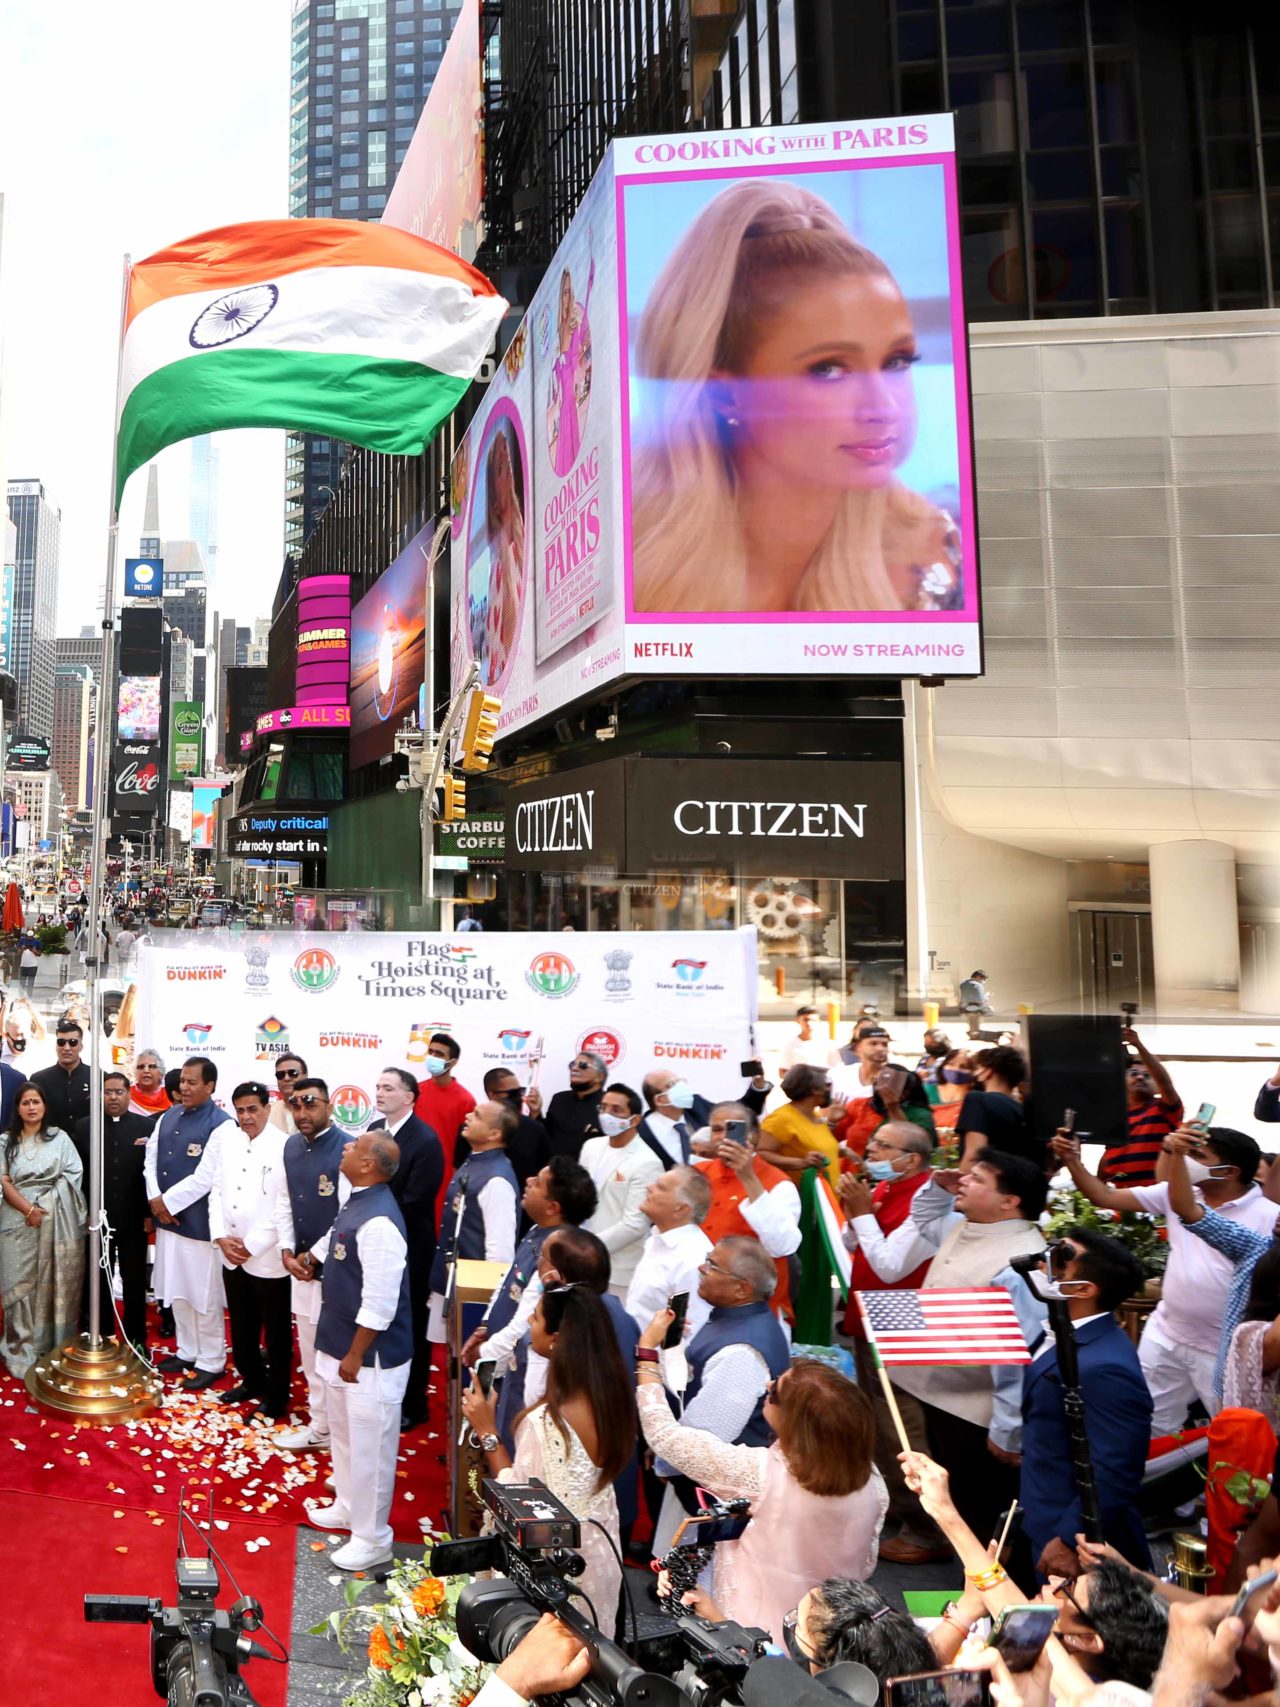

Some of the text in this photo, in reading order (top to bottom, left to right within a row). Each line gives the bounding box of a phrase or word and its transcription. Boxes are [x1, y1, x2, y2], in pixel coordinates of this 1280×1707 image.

[634, 124, 929, 165] COOKING WITH PARIS
[544, 447, 599, 534] COOKING
[560, 502, 578, 532] WITH
[544, 498, 600, 595] PARIS
[299, 629, 346, 644] SUMMER
[297, 640, 347, 653] UN&GAMES
[634, 642, 694, 659] NETFLIX
[803, 643, 965, 658] NOW STREAMING
[280, 713, 292, 722] abc
[302, 709, 330, 722] ALL
[251, 818, 277, 831] Deputy
[515, 790, 593, 853] CITIZEN
[673, 801, 868, 838] CITIZEN
[251, 840, 273, 854] rocky
[275, 840, 304, 852] start
[307, 839, 320, 852] in
[622, 883, 681, 897] CITIZEN
[407, 940, 452, 964] Flag
[167, 968, 226, 981] DUNKIN'
[371, 958, 468, 985] Hoisting
[473, 965, 500, 988] at
[358, 975, 426, 998] Times
[430, 979, 509, 1006] Square
[256, 1043, 290, 1052] TV ASIA
[319, 1036, 382, 1049] DUNKIN'
[654, 1046, 728, 1060] DUNKIN'
